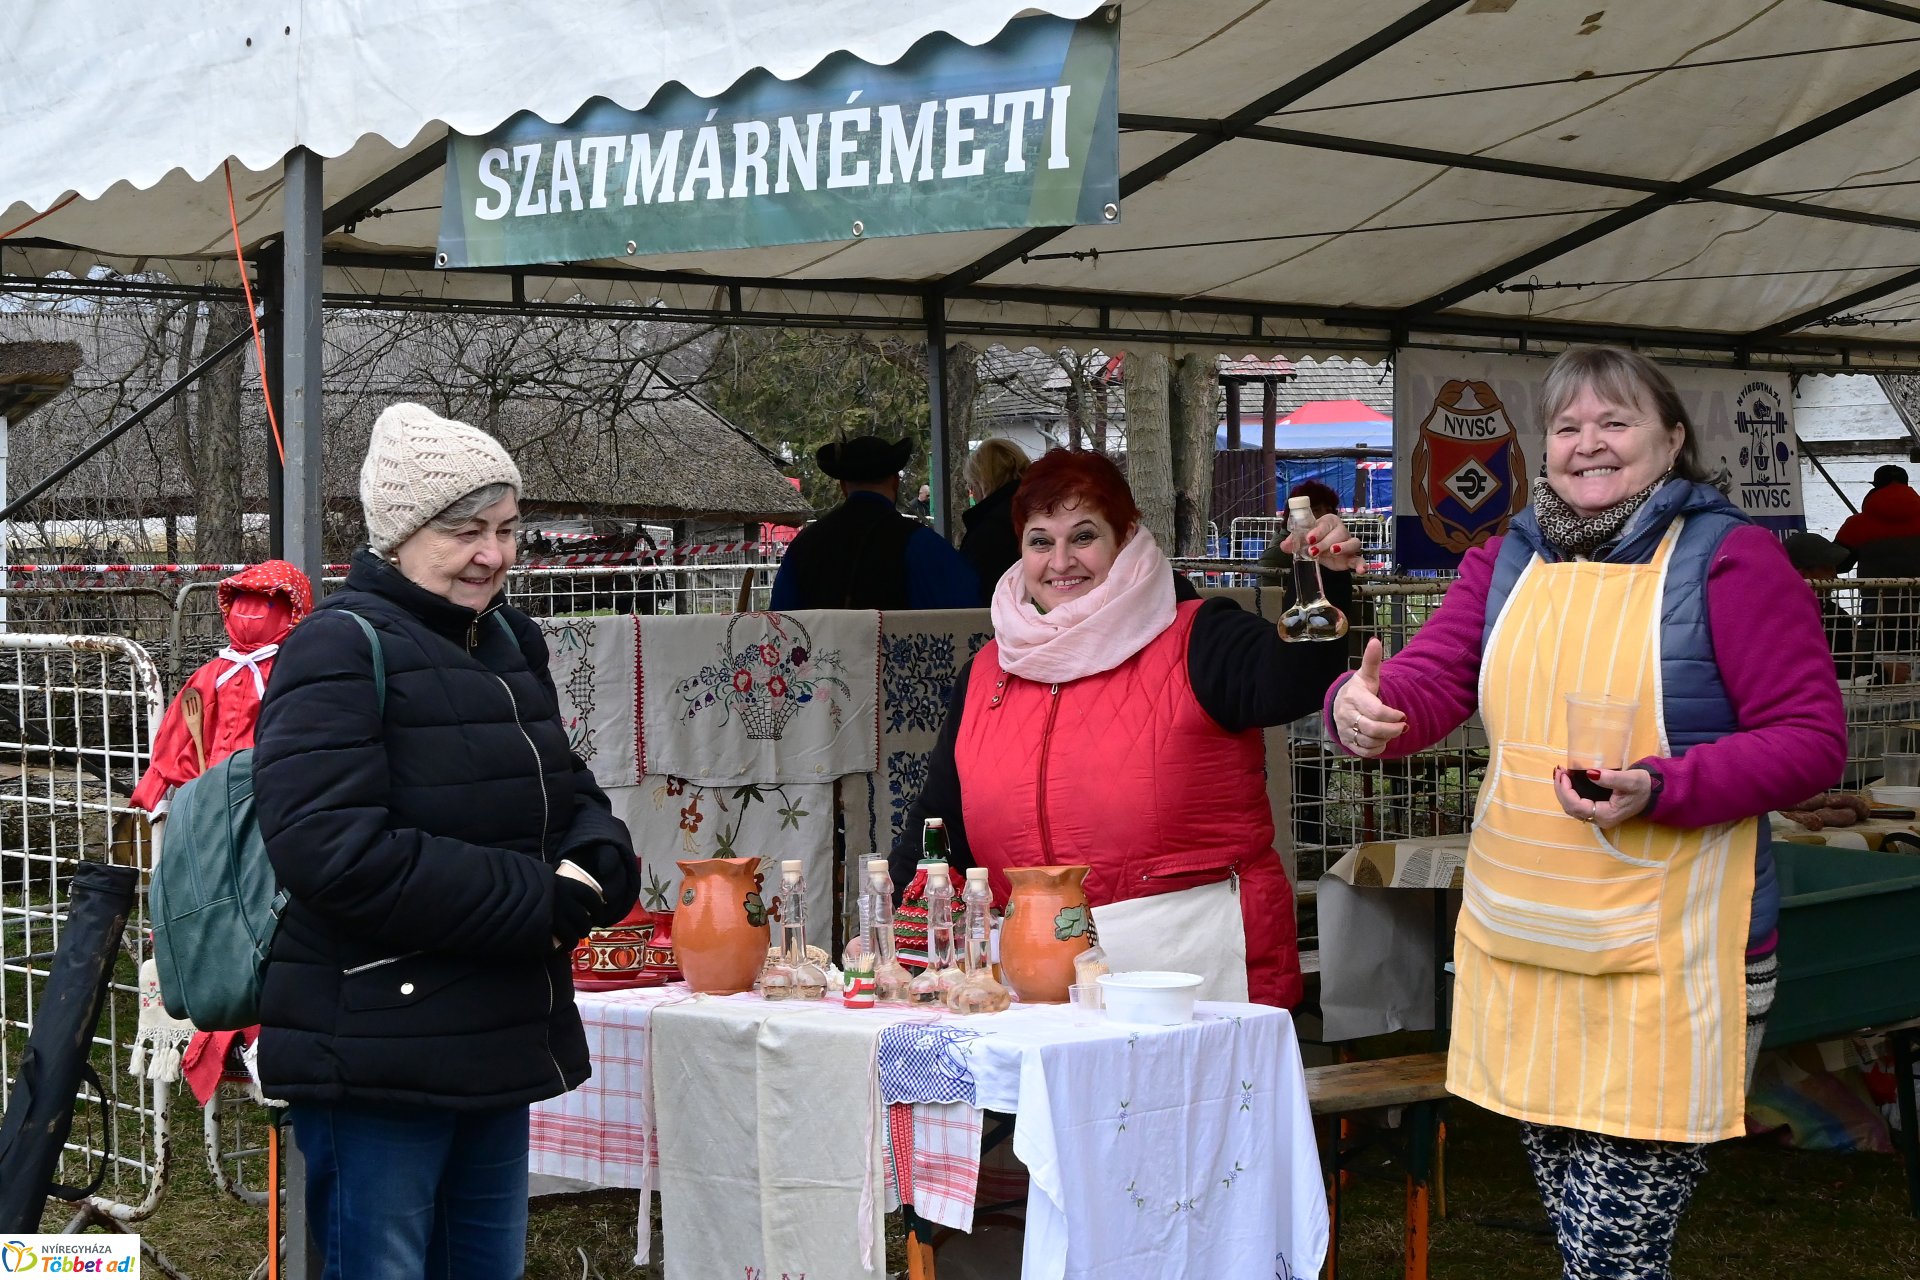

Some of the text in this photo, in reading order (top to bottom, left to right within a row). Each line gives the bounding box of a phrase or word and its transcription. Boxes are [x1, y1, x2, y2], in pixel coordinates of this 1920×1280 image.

[474, 85, 1072, 221] SZATMÁRNÉMETI
[1444, 414, 1496, 437] NYVSC
[1741, 488, 1791, 509] NYVSC
